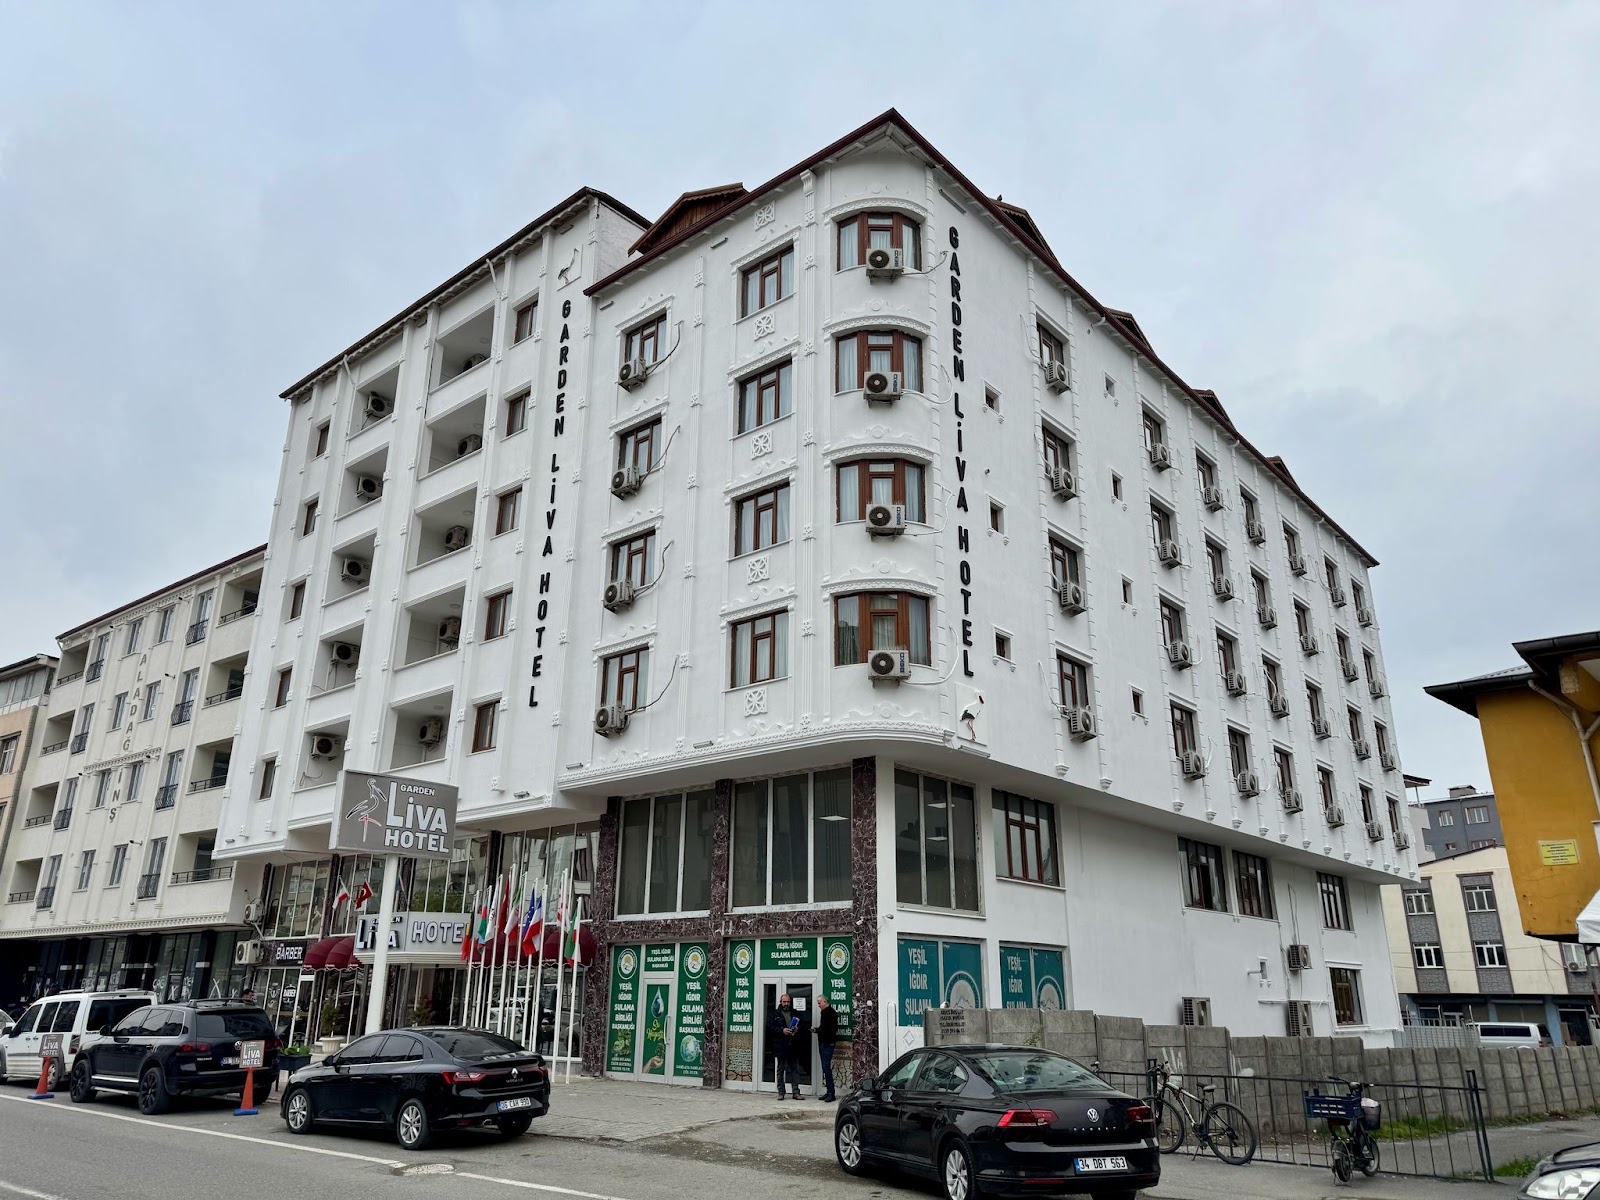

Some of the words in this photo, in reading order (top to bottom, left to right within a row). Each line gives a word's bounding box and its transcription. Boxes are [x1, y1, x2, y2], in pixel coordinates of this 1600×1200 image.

[554, 299, 571, 438] GARDEN
[949, 226, 964, 382] GARDEN
[957, 525, 974, 677] HOTEL
[528, 572, 551, 707] HOTEL
[122, 653, 147, 751] ALADAĞ
[400, 784, 435, 796] GARDEN
[384, 828, 449, 853] HOTEL
[412, 921, 465, 943] HOTE
[276, 946, 302, 960] BARBER
[908, 945, 927, 968] YEŞİL
[1007, 952, 1022, 974] YEŞİL
[909, 970, 928, 990] IĞDIR
[1009, 975, 1023, 993] IĞDIR
[732, 1002, 752, 1010] SULAMA
[1080, 1159, 1090, 1169] 34
[1092, 1158, 1107, 1169] DBT
[1110, 1158, 1126, 1168] 563
